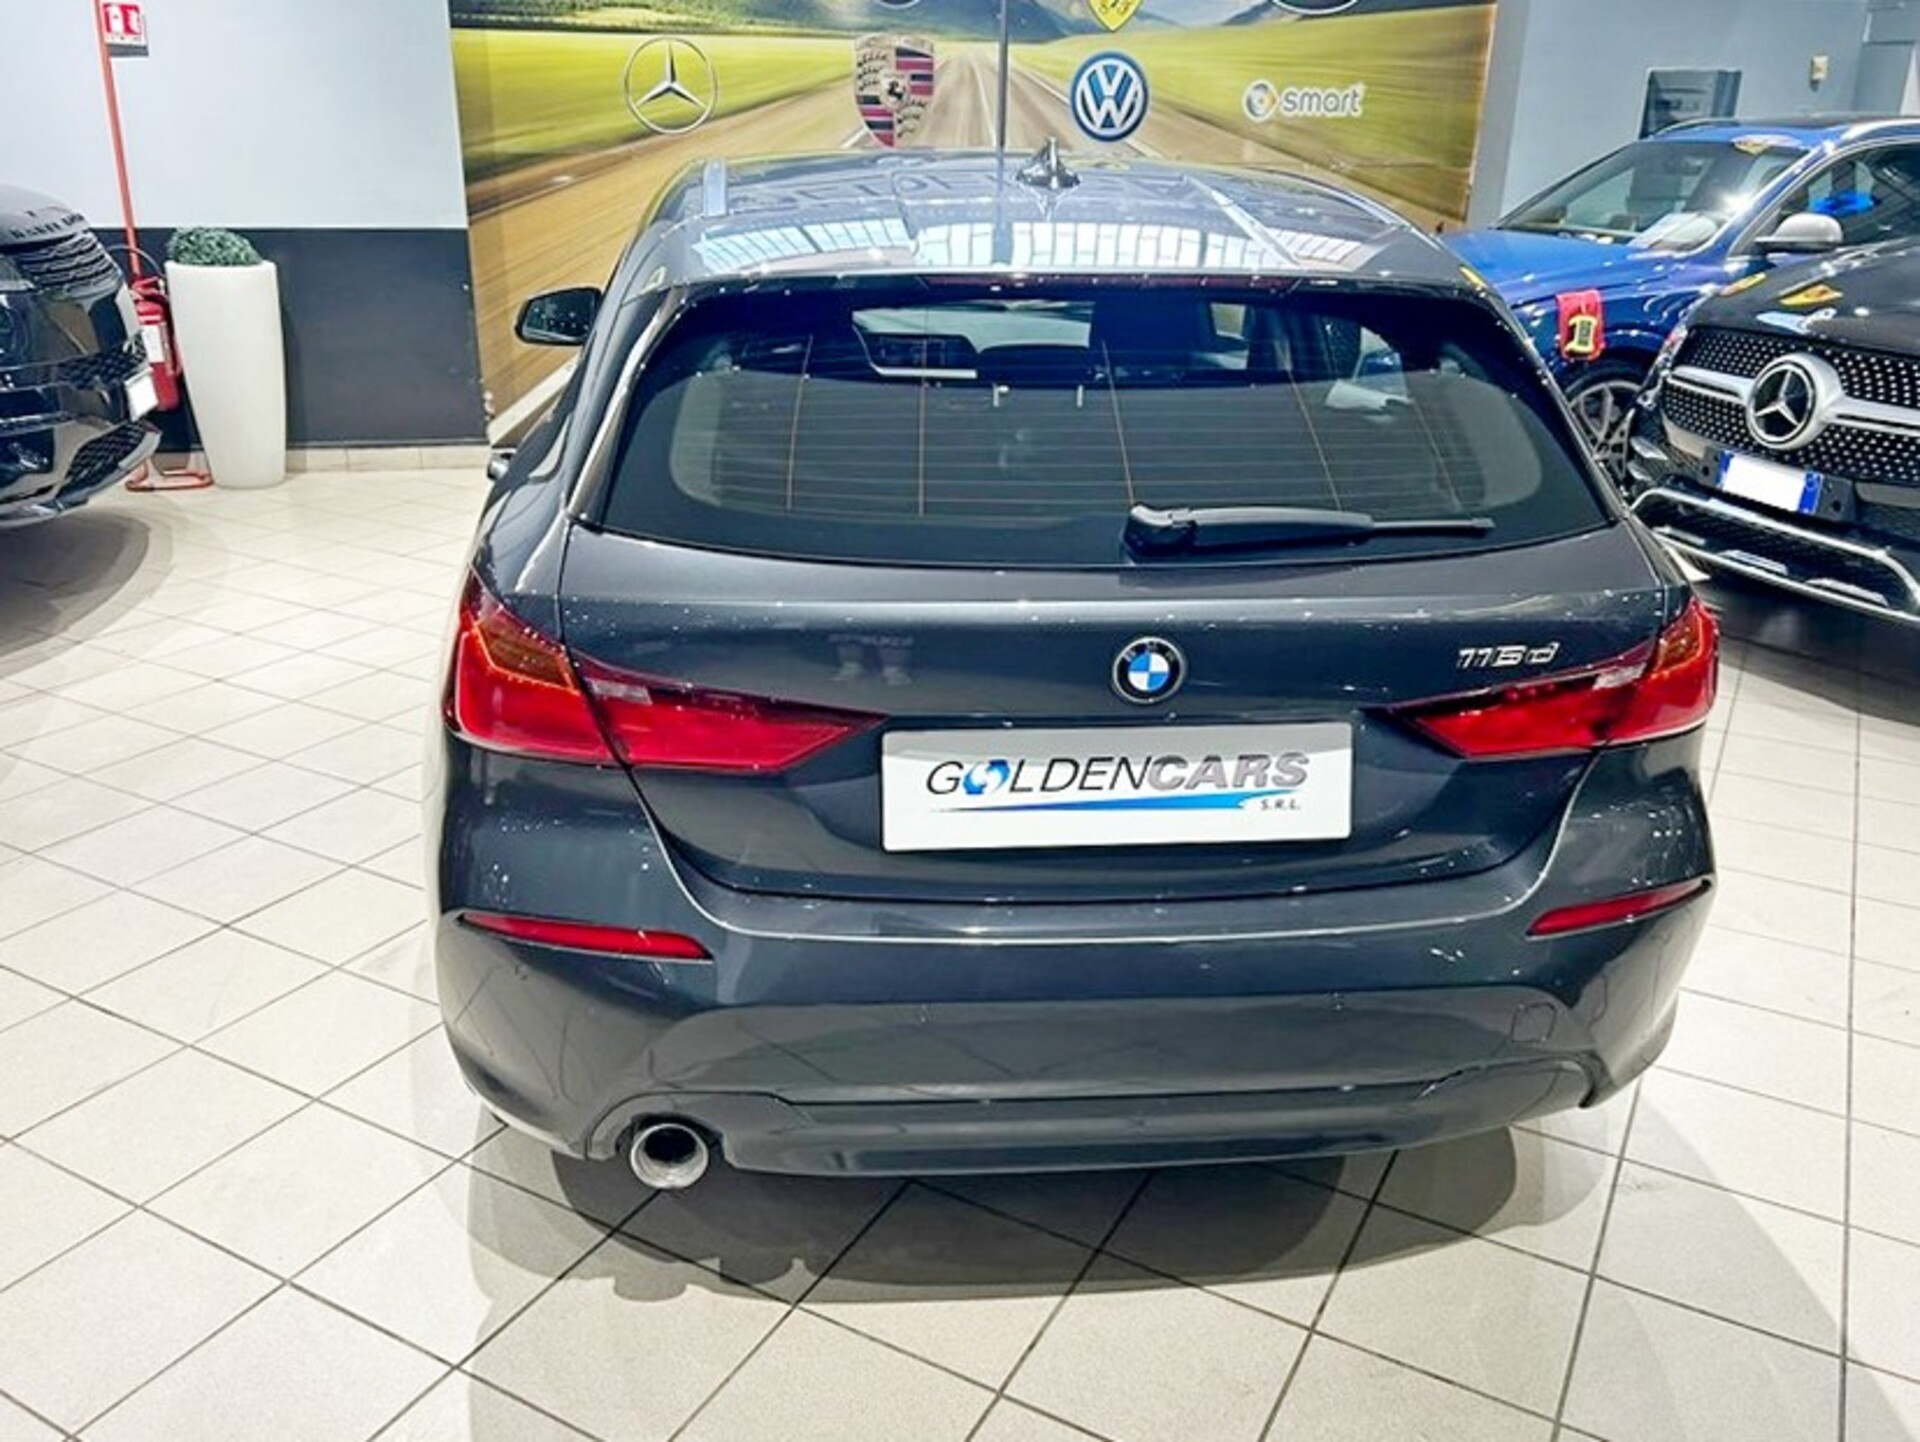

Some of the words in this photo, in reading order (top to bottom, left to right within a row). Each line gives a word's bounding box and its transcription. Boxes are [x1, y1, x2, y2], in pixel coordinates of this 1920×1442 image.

[1077, 57, 1143, 134] VW
[1282, 89, 1360, 113] smart
[926, 752, 1310, 795] GOLDENCARS
